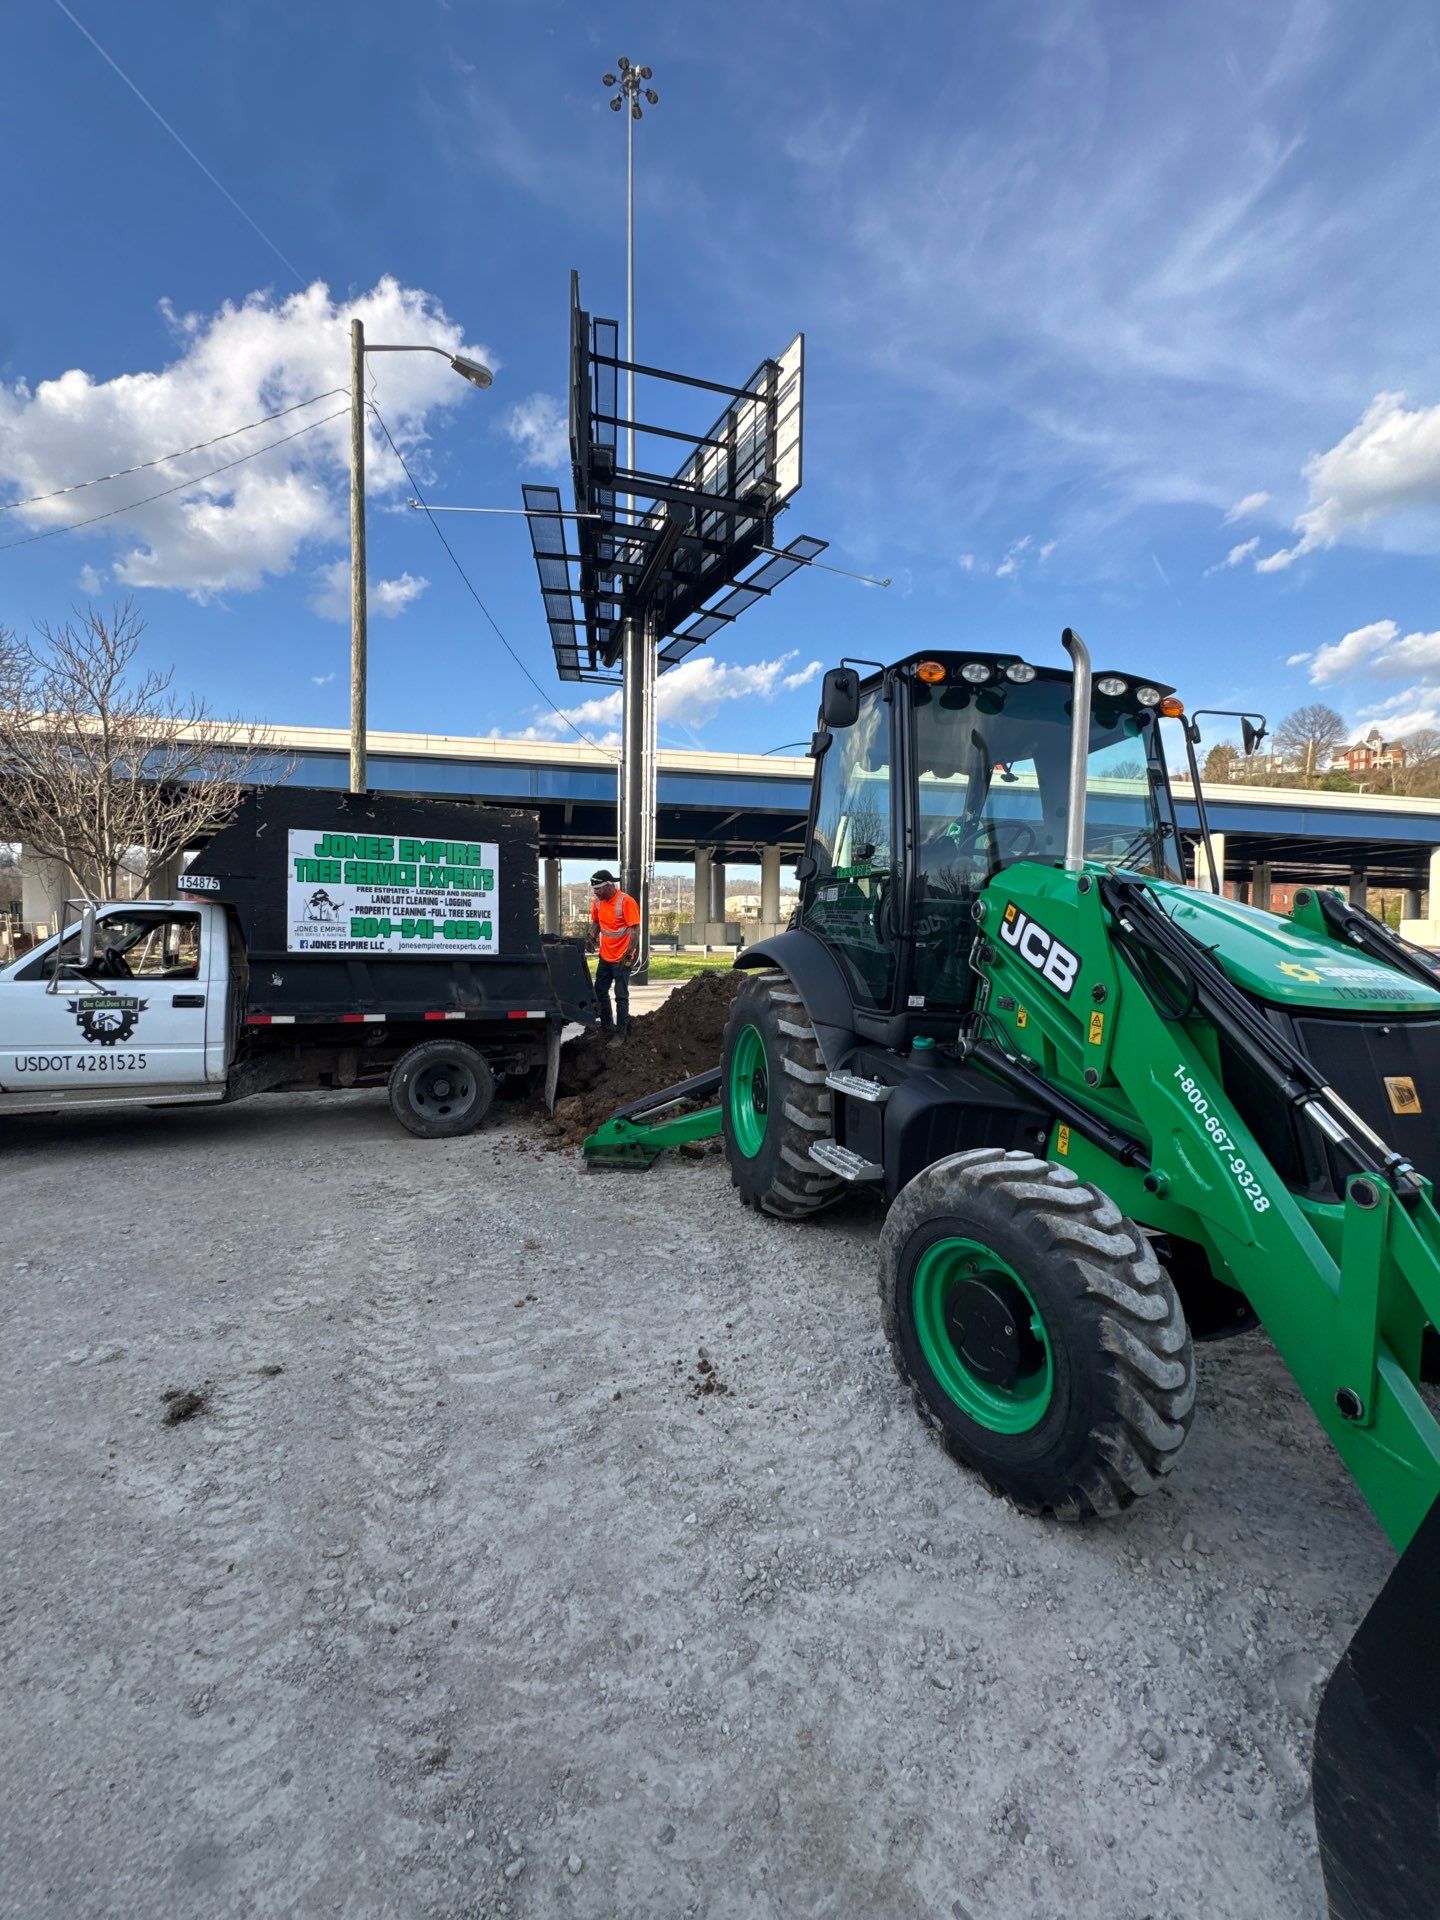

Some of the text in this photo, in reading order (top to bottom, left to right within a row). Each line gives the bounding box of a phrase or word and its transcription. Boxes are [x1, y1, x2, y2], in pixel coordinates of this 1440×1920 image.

[315, 834, 481, 866] JONES EMPIRE
[294, 858, 494, 891] TREE SERVICE EXPERTS
[180, 877, 219, 889] 154875
[374, 887, 410, 895] ESTIMATES
[405, 896, 439, 906] CLEARING
[444, 898, 472, 907] LOGGING
[355, 906, 391, 915] PROPERTY
[392, 907, 427, 917] CLEANING
[449, 909, 464, 918] TREE
[466, 910, 491, 919] SERVICE
[320, 926, 347, 934] EMPIRE
[350, 917, 492, 940] 304-541-8934
[310, 941, 337, 949] JONES
[338, 941, 368, 950] EMPIRE
[370, 942, 385, 950] LLC
[398, 941, 492, 951] jonesempiretreeexperts.com
[1000, 912, 1079, 993] JCB
[15, 1053, 147, 1072] USDOT 4281525
[1173, 1064, 1270, 1213] 1-800-667-9328
